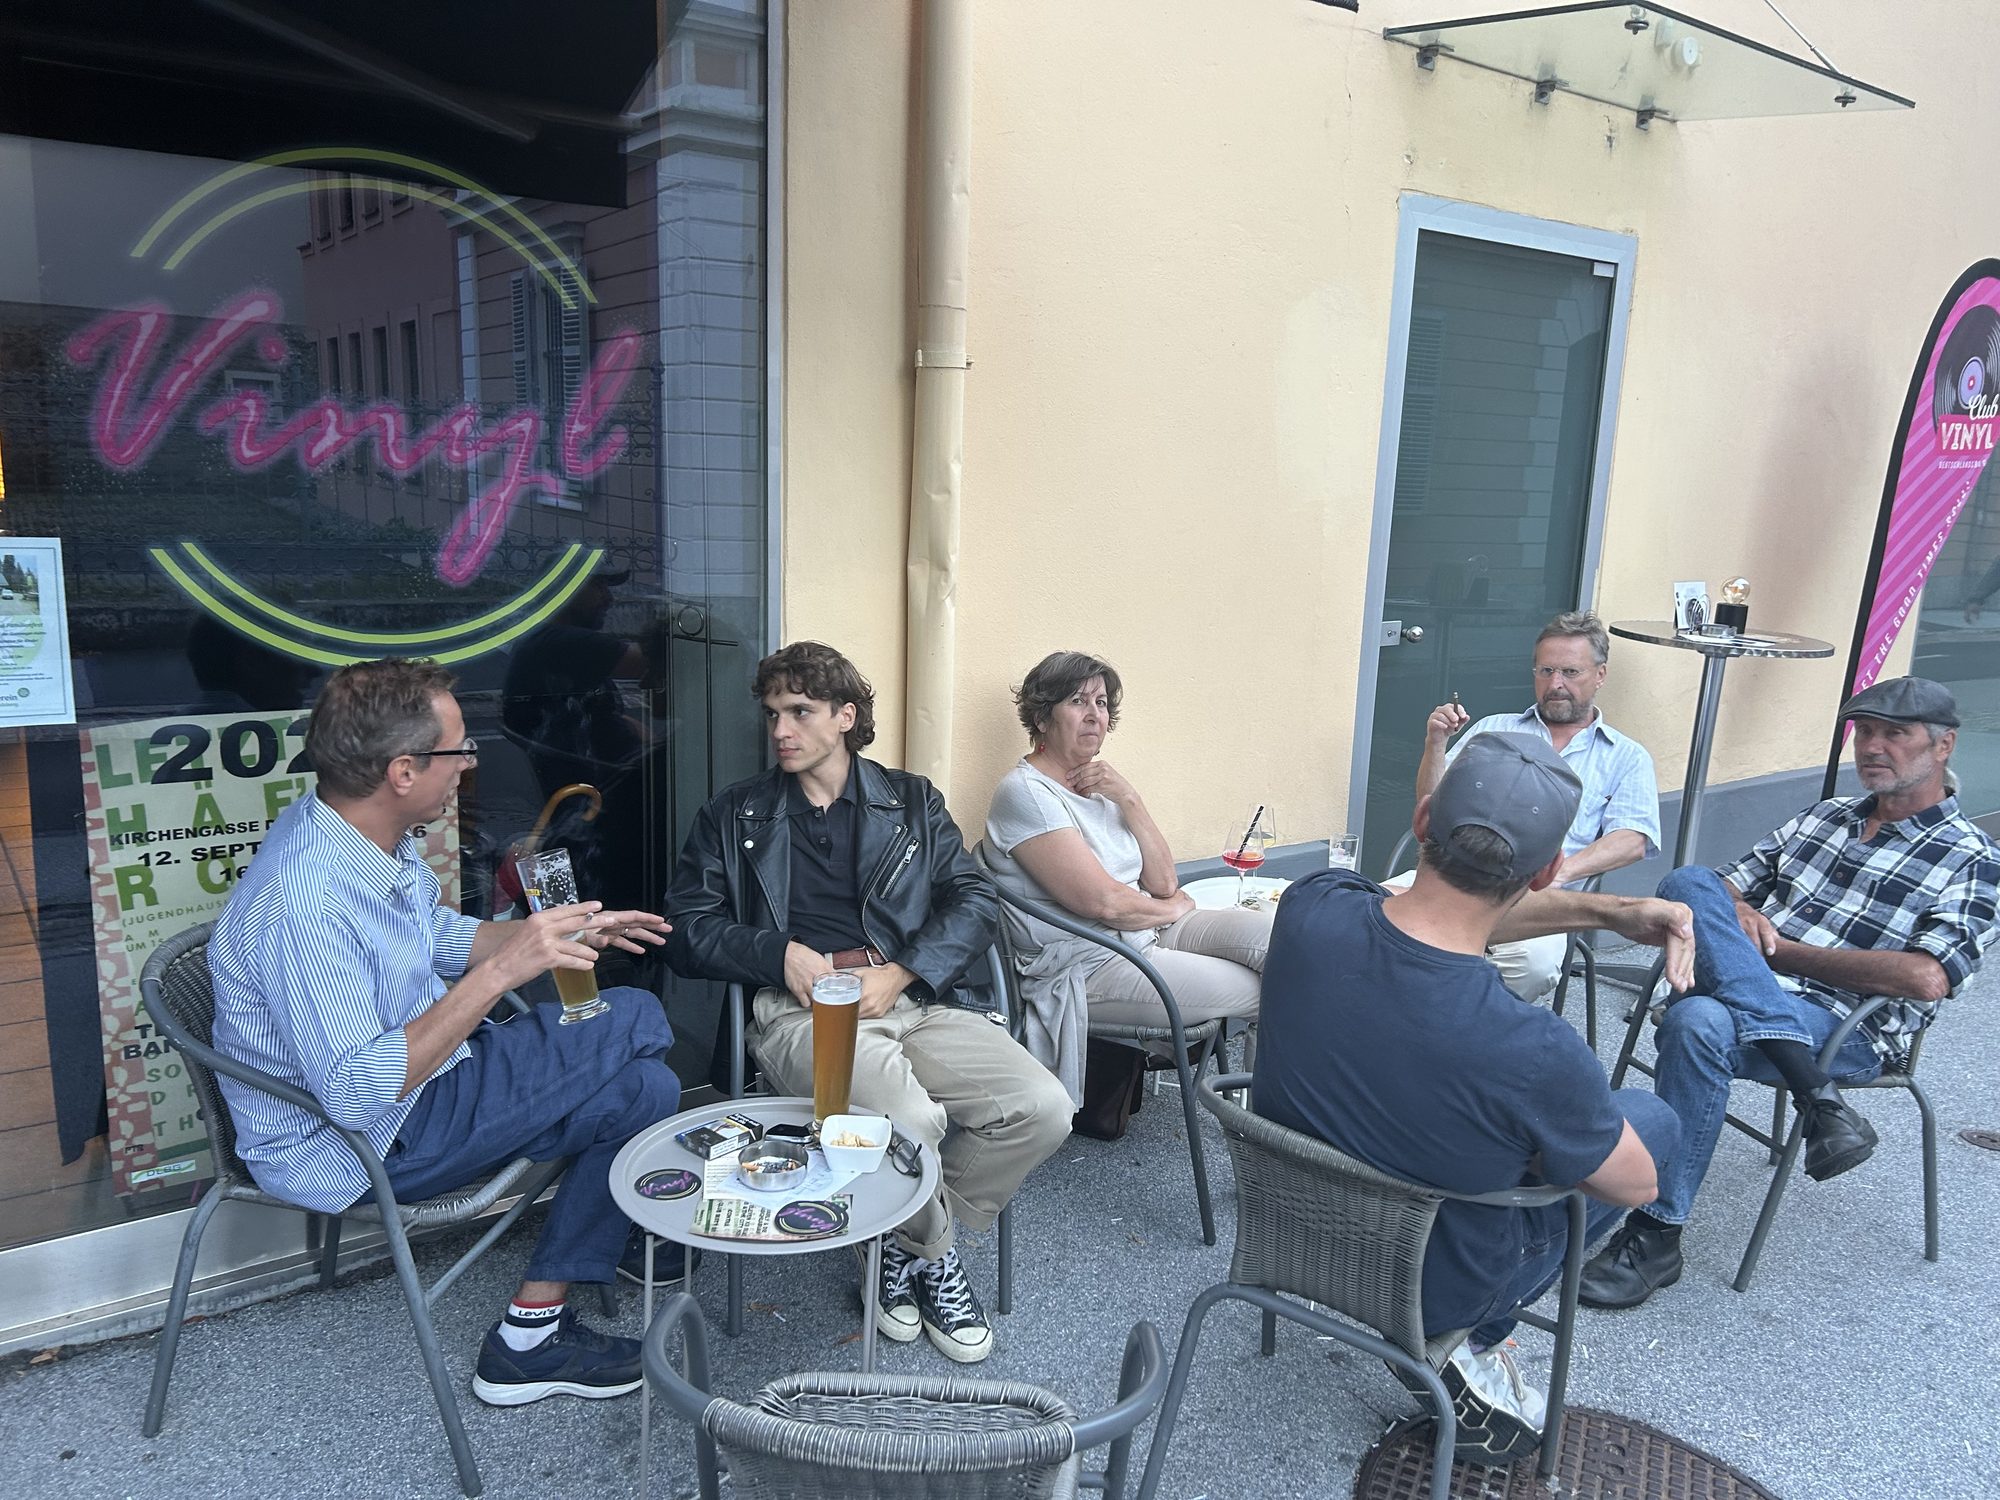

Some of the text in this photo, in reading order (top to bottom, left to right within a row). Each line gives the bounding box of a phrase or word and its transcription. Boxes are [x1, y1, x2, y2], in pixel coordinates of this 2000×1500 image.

[1968, 393, 2000, 420] Club
[68, 288, 641, 586] Vinyl
[1941, 422, 1994, 450] VINYL
[1855, 669, 1875, 696] ET
[1874, 633, 1893, 664] THE
[110, 820, 259, 846] KIRCHENGASSE
[137, 850, 181, 867] 12.
[122, 899, 228, 928] (JUGENDHAUS
[640, 1171, 693, 1195] Vinyl
[518, 1306, 558, 1317] Levi's
